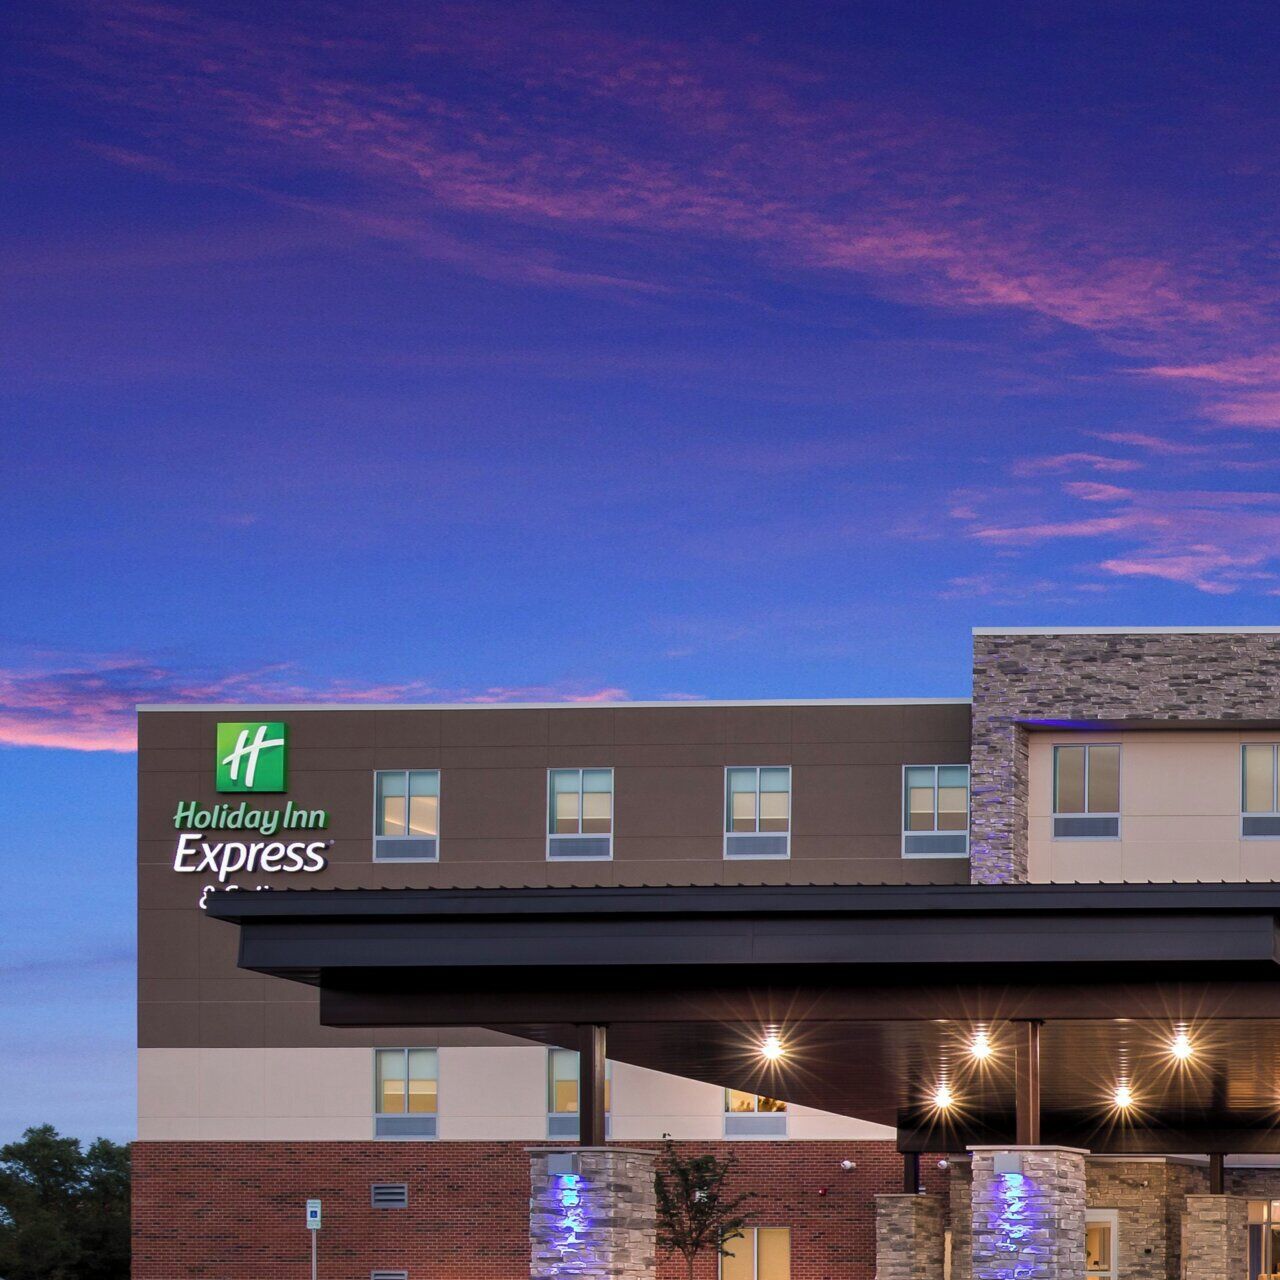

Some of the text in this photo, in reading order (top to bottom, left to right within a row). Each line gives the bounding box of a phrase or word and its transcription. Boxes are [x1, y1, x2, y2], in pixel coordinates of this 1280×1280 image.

[173, 801, 327, 836] Holiday Inn
[173, 833, 326, 883] Express
